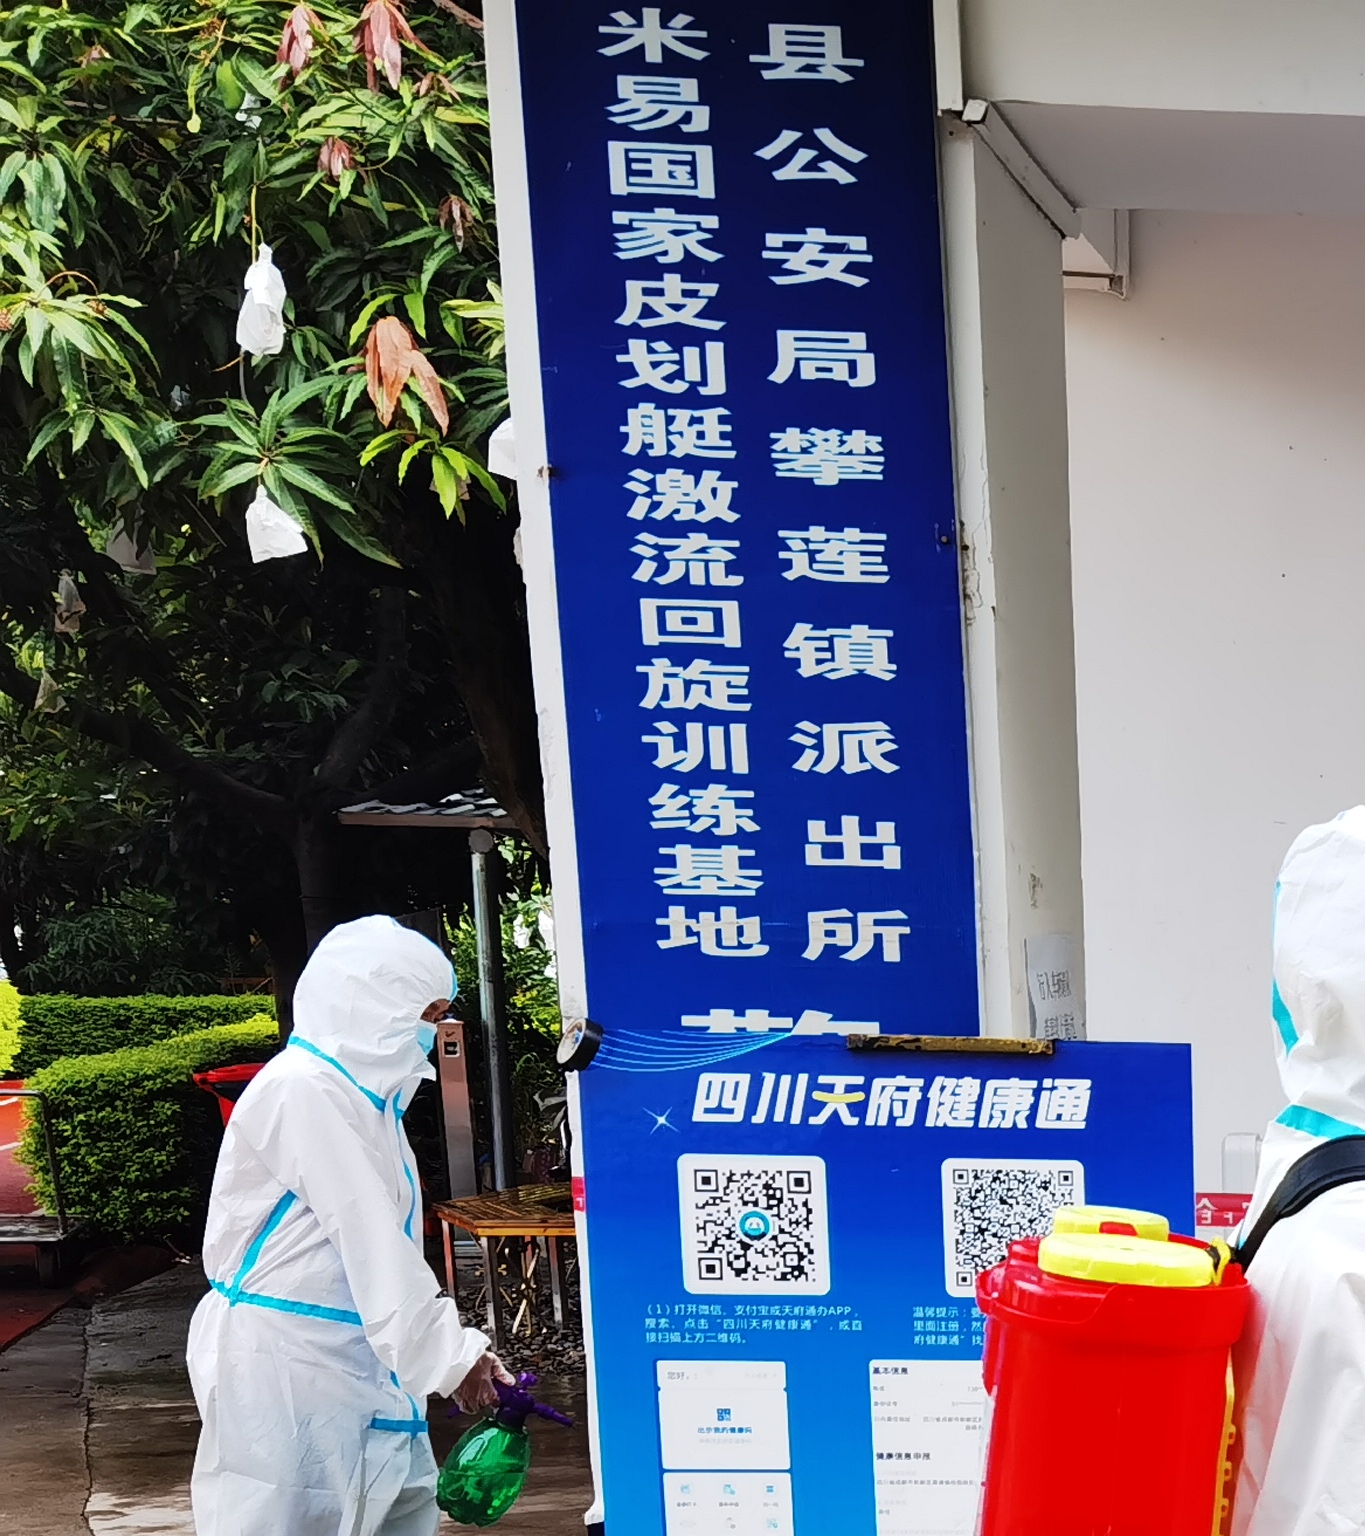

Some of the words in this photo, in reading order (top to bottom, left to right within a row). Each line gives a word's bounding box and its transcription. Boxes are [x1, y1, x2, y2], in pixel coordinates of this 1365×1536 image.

[597, 8, 769, 957] 米易国家皮划艇激流回旋训练基地
[749, 24, 911, 962] 县公安局攀莲镇派出所
[692, 1072, 1092, 1130] 四川天府健康通
